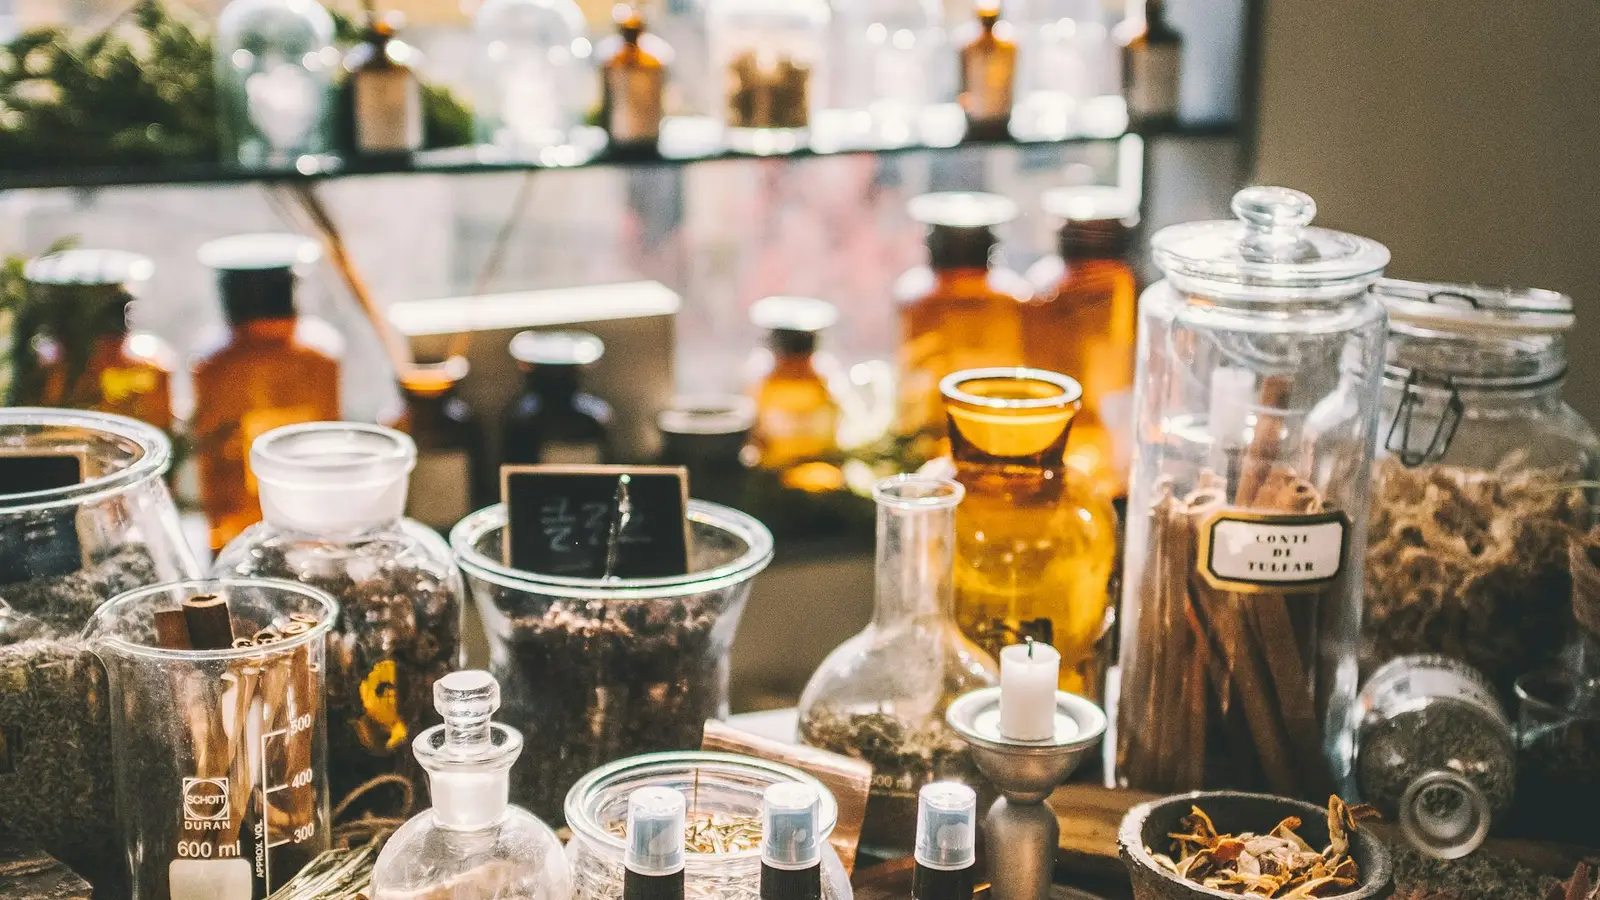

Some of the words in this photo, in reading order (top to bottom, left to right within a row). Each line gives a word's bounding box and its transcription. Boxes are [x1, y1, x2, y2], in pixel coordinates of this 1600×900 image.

[290, 713, 311, 734] 500
[291, 768, 313, 788] 400
[185, 794, 226, 805] SCHOTT
[184, 820, 231, 831] DURAN
[293, 822, 315, 844] 300
[177, 840, 212, 858] 600
[218, 840, 241, 857] ml
[255, 840, 264, 878] APPROX.
